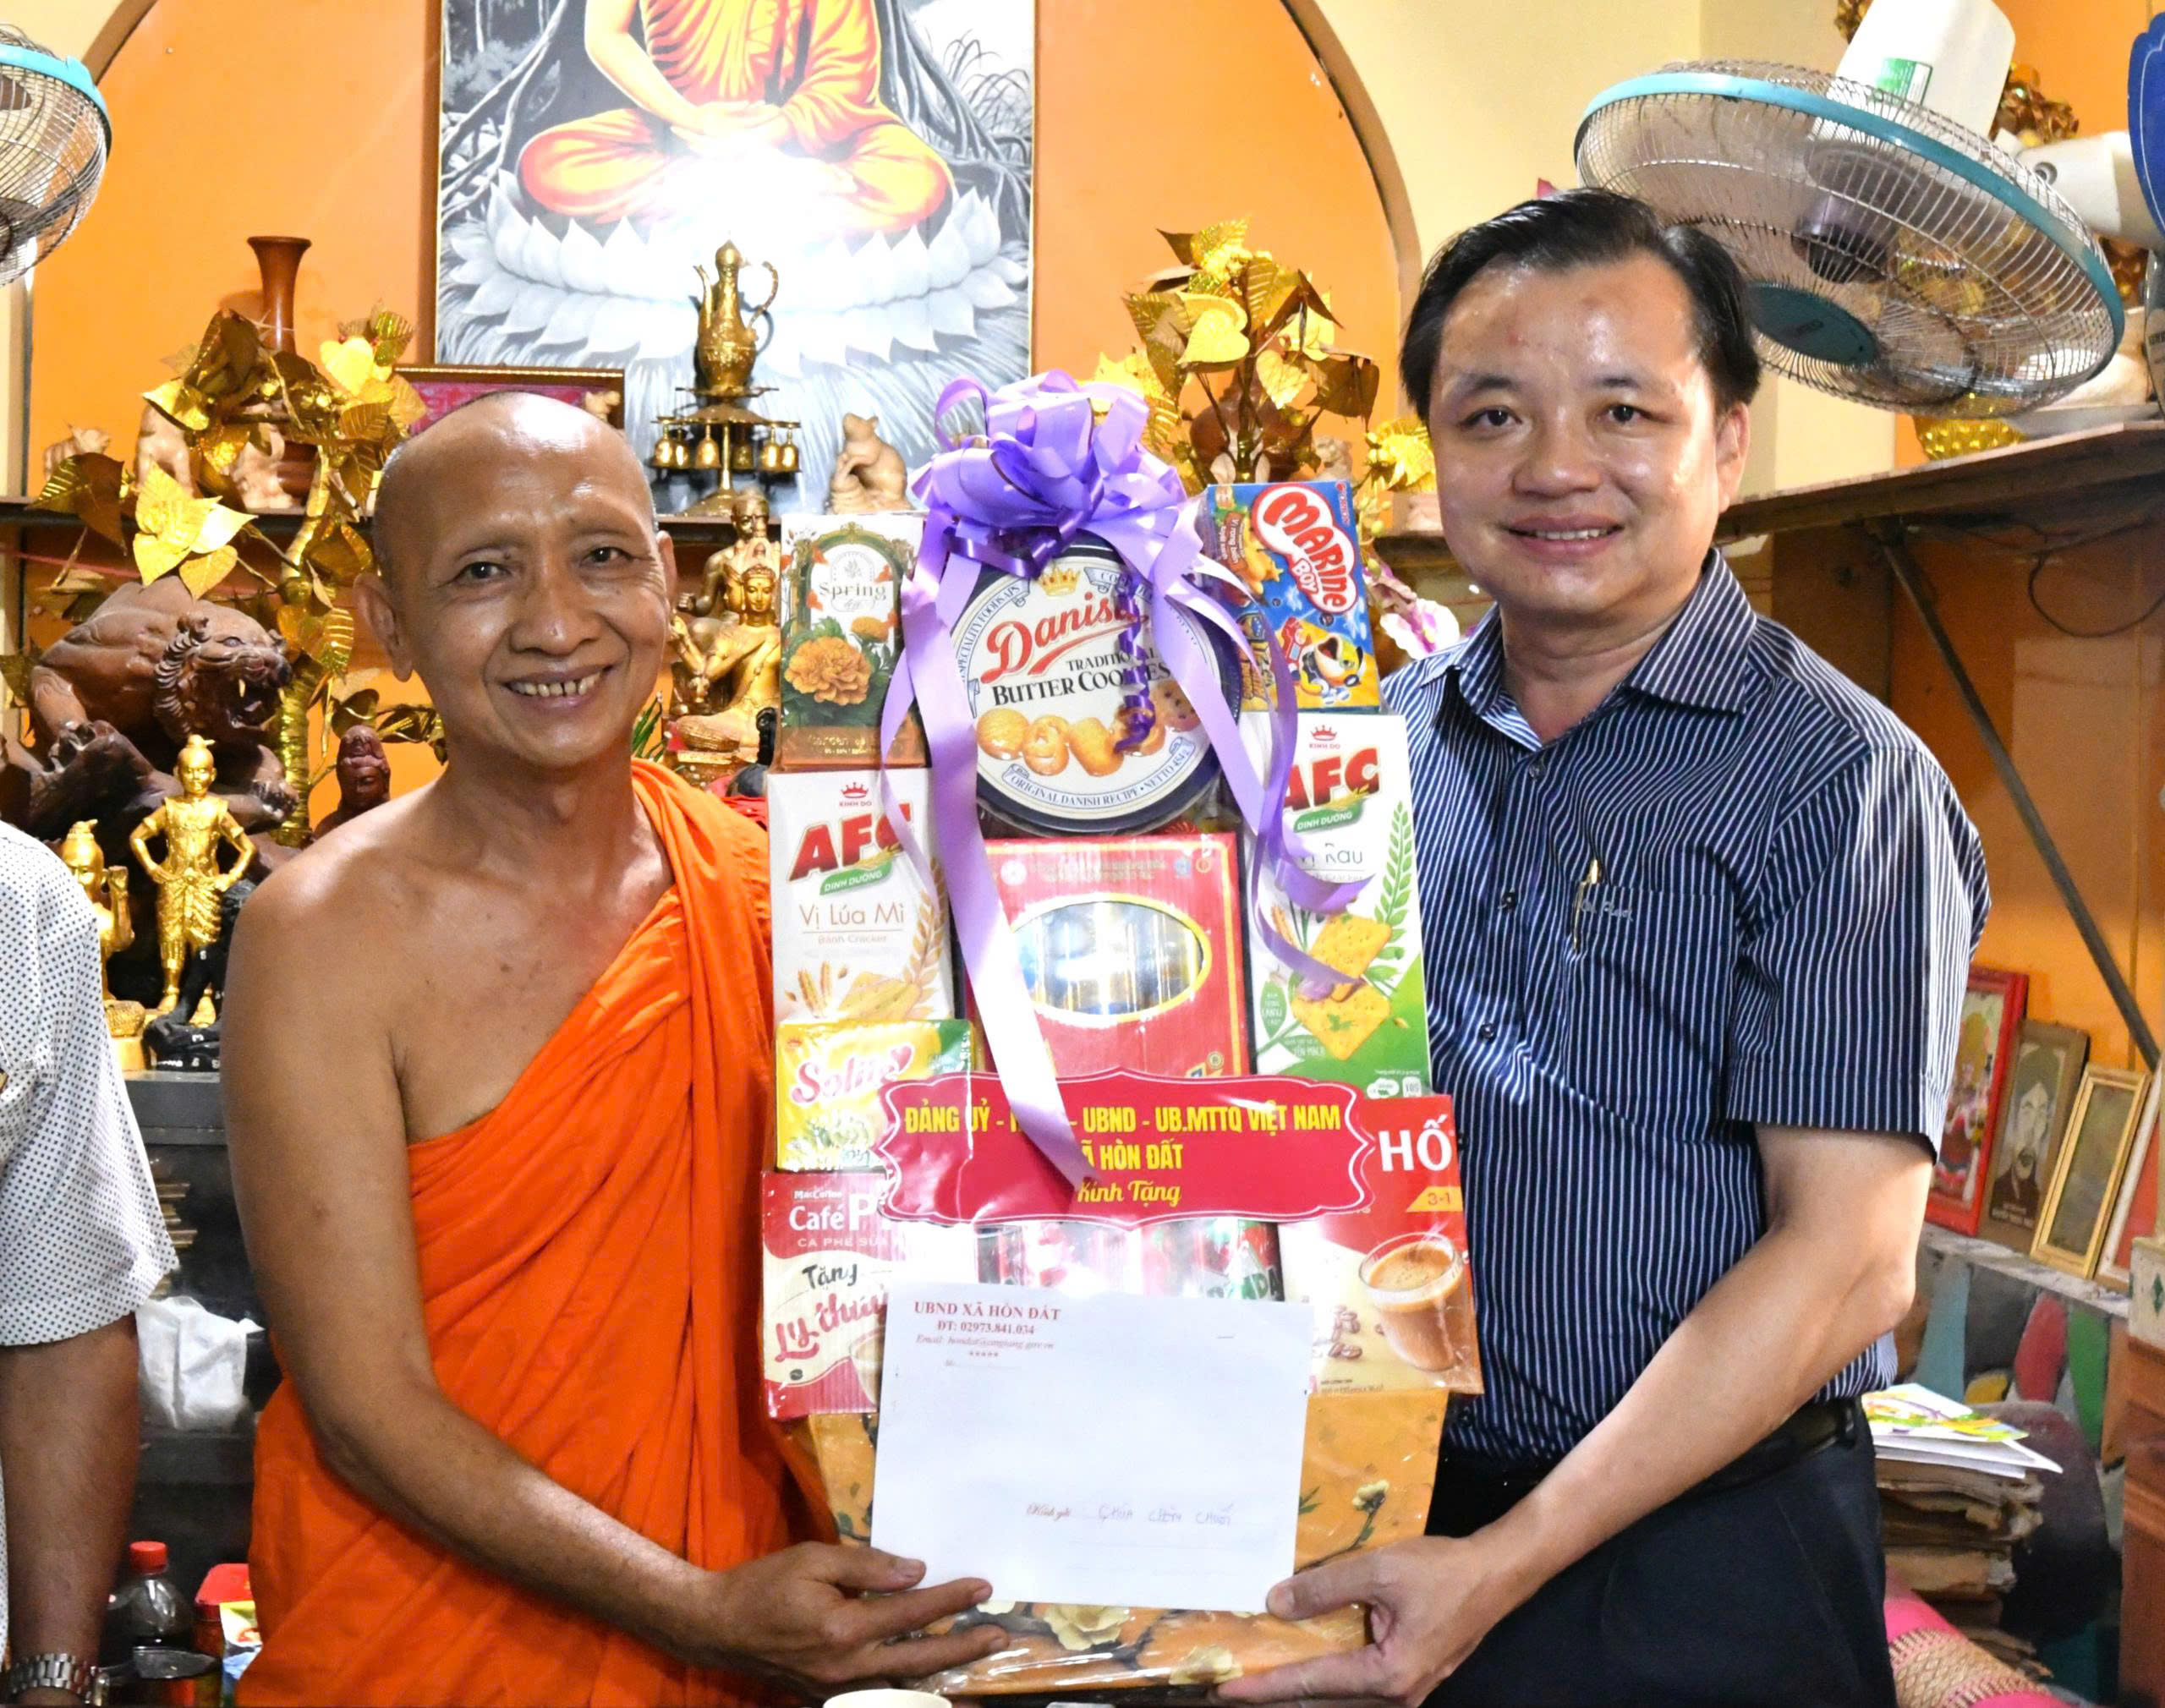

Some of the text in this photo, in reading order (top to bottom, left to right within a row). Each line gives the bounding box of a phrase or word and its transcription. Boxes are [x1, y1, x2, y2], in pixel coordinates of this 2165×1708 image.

[819, 581, 887, 601] Spring
[1066, 647, 1159, 673] TRADITIOL
[992, 661, 1171, 706] BUTTER COOES
[1011, 775, 1057, 802] ORIGINAL
[1061, 794, 1099, 806] DANISH
[1103, 787, 1140, 806] RECIPE
[1143, 766, 1175, 788] NETTO
[799, 902, 905, 930] Vị Lúa Mì
[905, 1098, 960, 1133] ĐẢNG
[1083, 1106, 1136, 1133] UBND
[1155, 1106, 1242, 1133] UB.MTTQ
[1247, 1100, 1287, 1136] VIỆT
[1293, 1105, 1341, 1131] NAM
[1100, 1139, 1141, 1170] HÒN
[1145, 1137, 1183, 1169] ĐẤT
[789, 1204, 845, 1230] Café
[914, 1301, 957, 1315] UBND
[962, 1301, 983, 1317] XÃ
[989, 1303, 1022, 1318] HÒN
[938, 1320, 956, 1331] ĐT:
